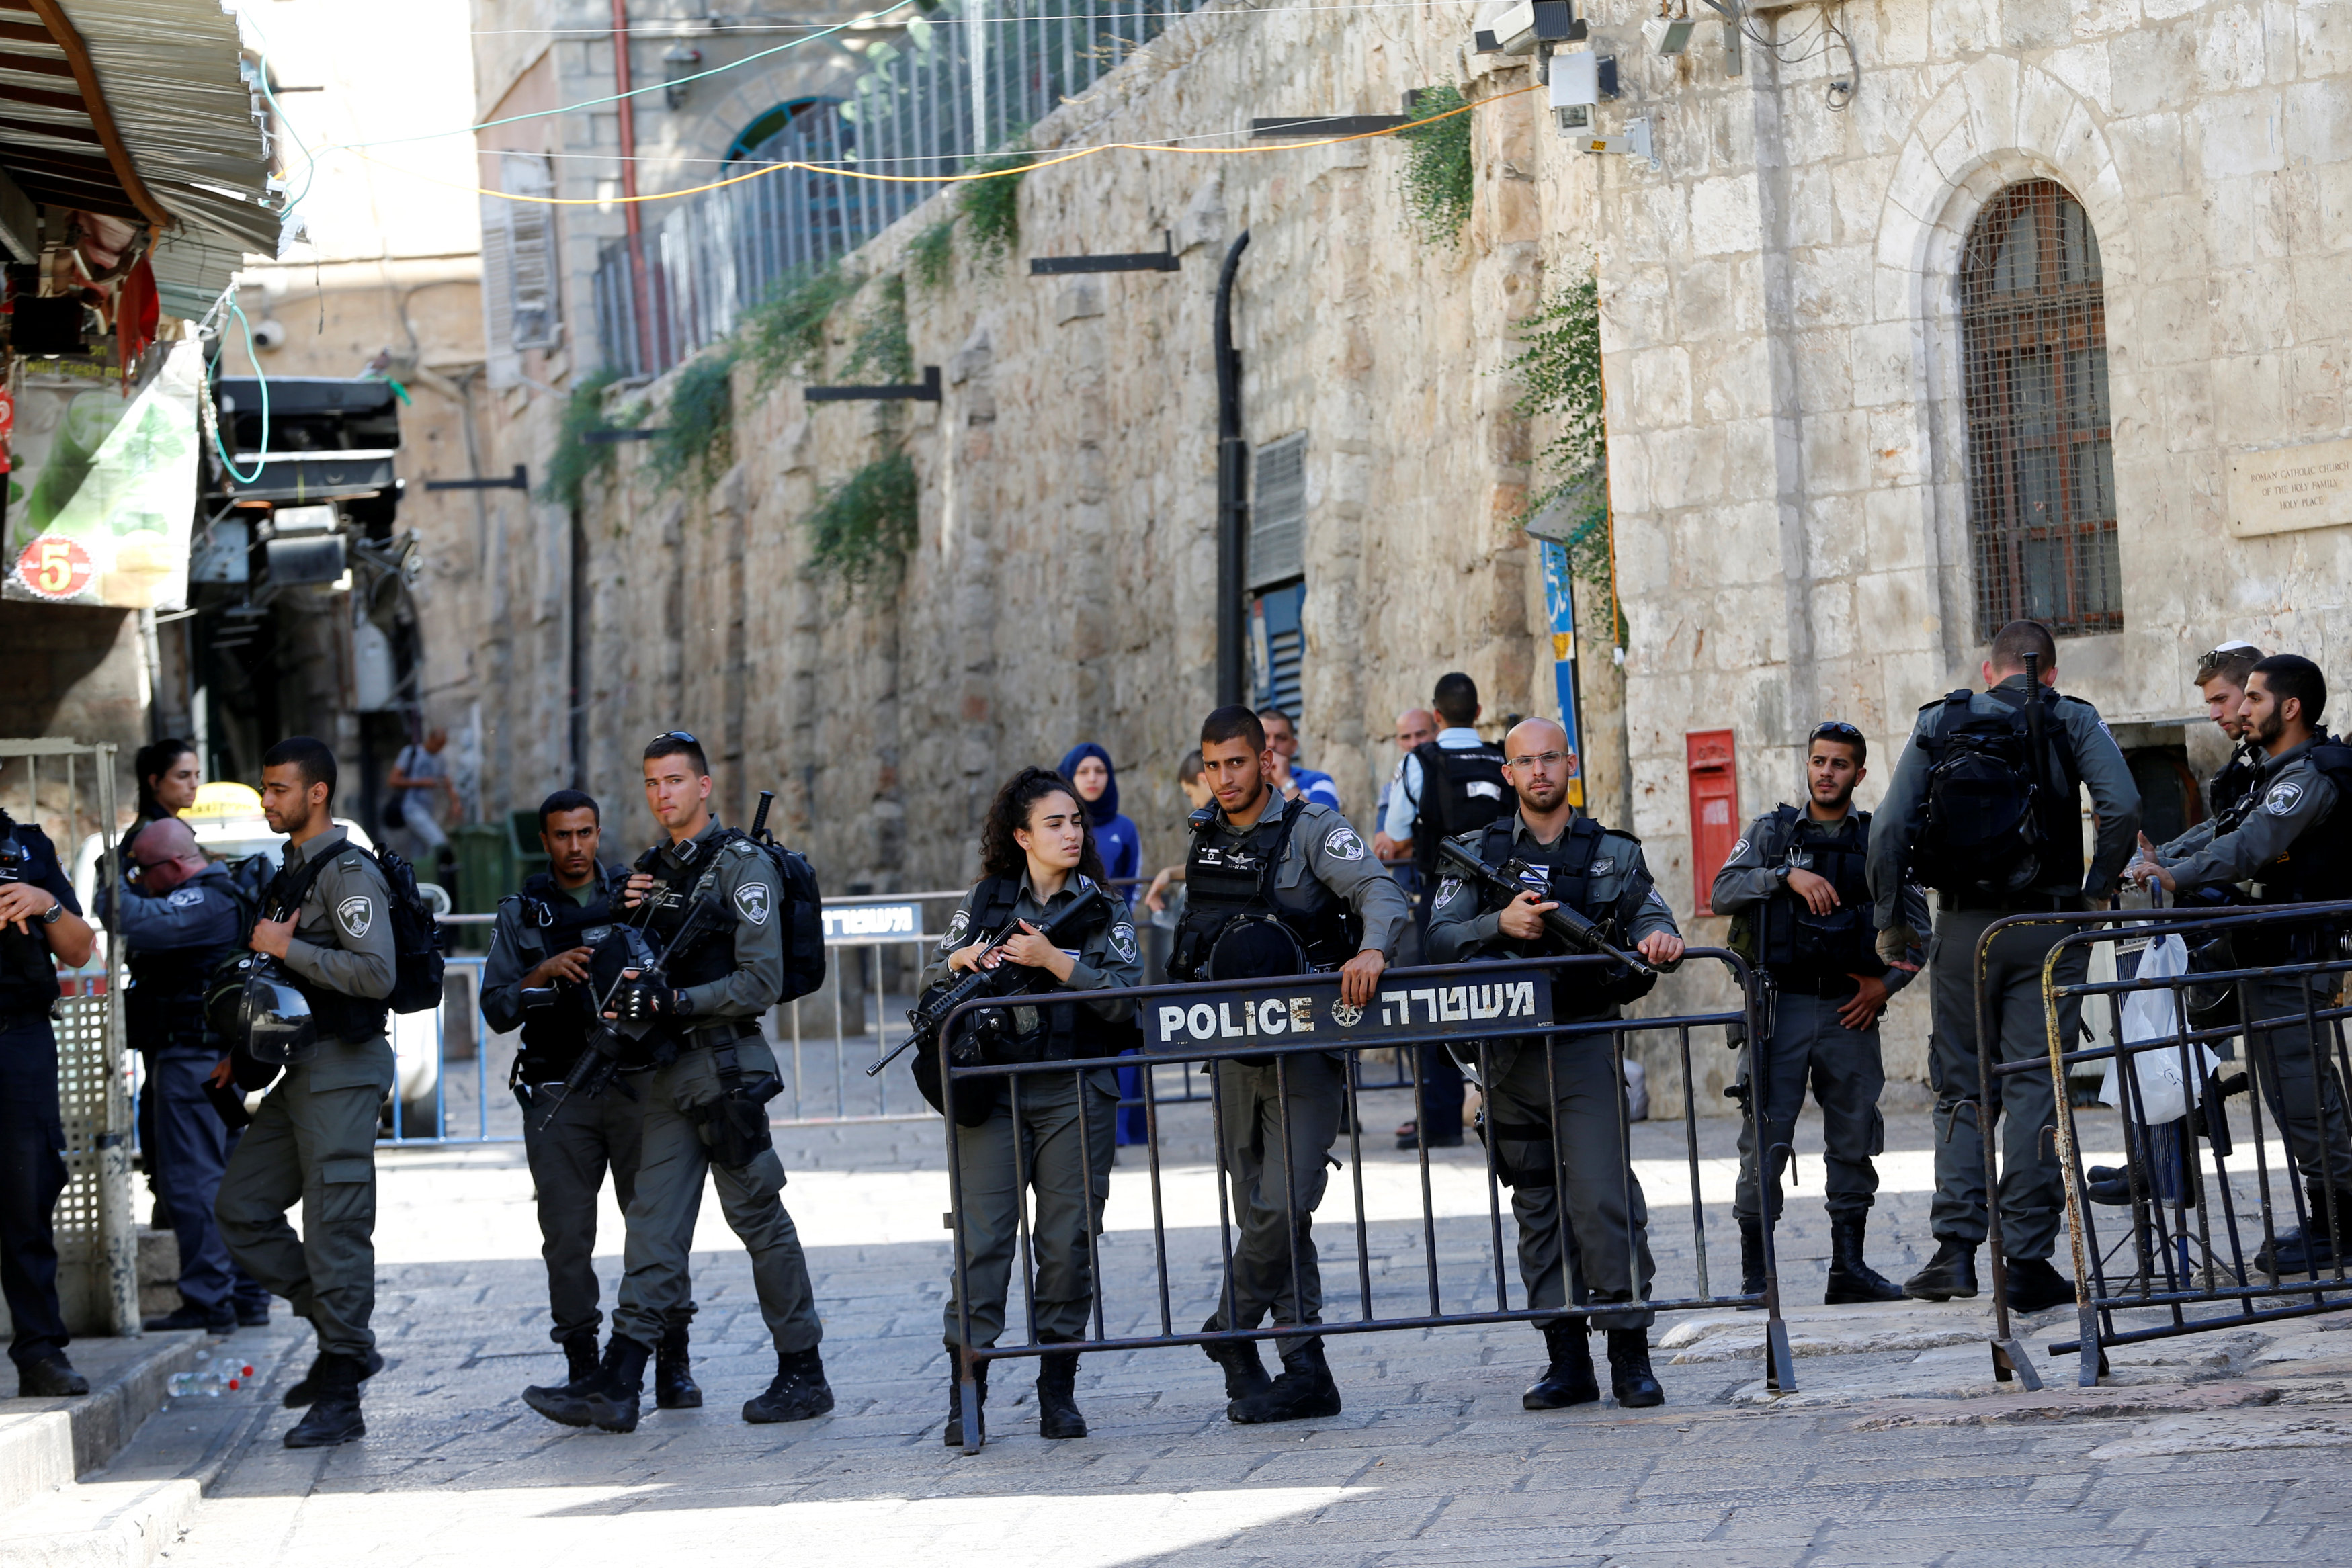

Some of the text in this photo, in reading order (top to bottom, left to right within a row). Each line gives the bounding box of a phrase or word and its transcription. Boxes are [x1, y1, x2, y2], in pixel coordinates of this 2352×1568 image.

[2251, 462, 2349, 482] ROMAN CATHOLIC CHURCH
[2262, 478, 2338, 496] OF THE HOLY FAMILY
[2279, 496, 2324, 510] HOLY PLACE
[39, 541, 72, 592] 5
[1159, 997, 1315, 1041] POLICE
[1381, 981, 1536, 1026] משטרה
